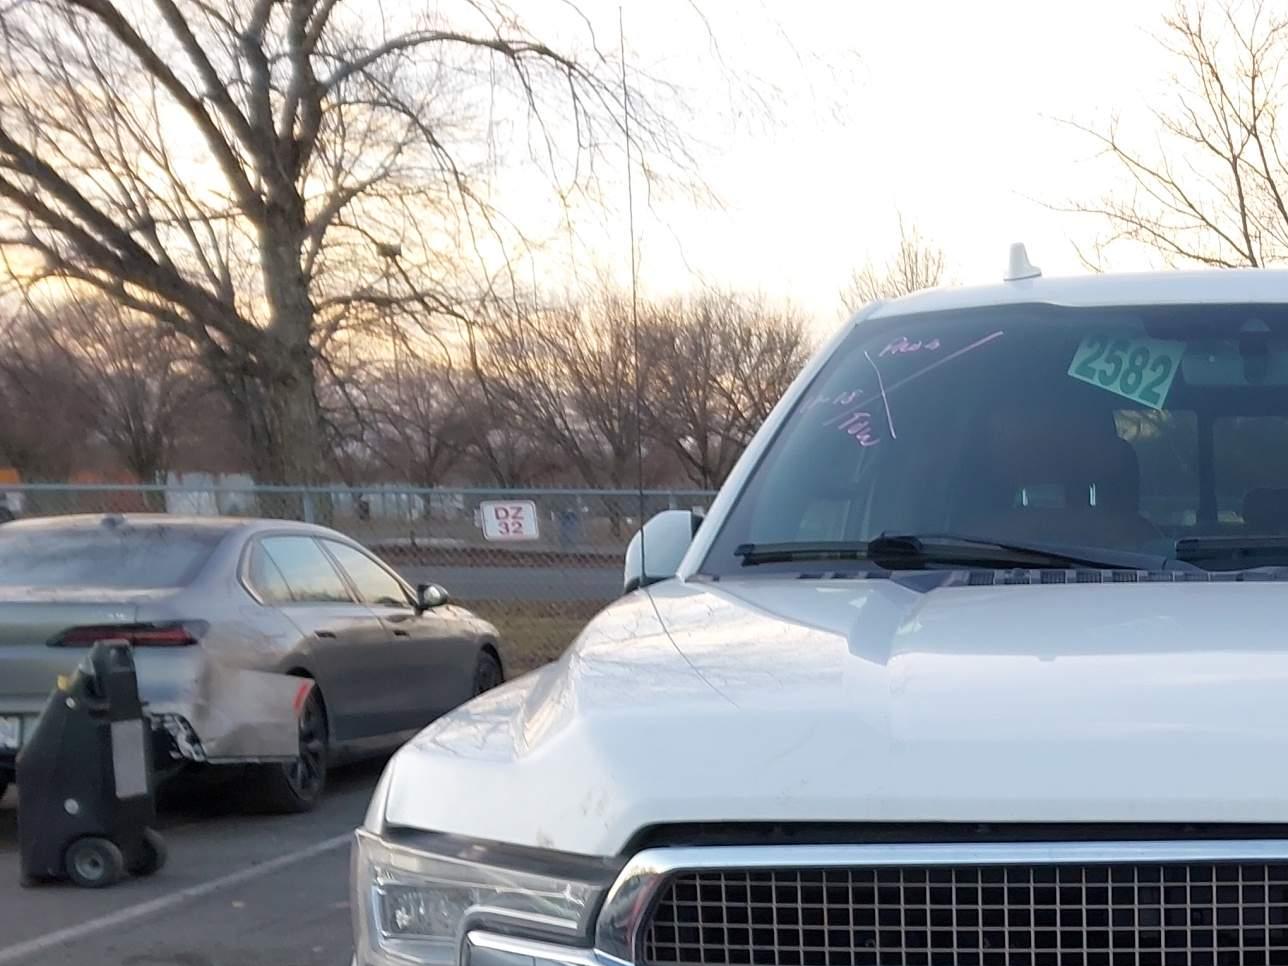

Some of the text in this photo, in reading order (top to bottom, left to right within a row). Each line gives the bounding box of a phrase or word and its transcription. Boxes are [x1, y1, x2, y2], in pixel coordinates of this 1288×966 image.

[1074, 334, 1173, 405] 2582
[494, 506, 525, 520] DZ
[498, 521, 524, 535] 32
